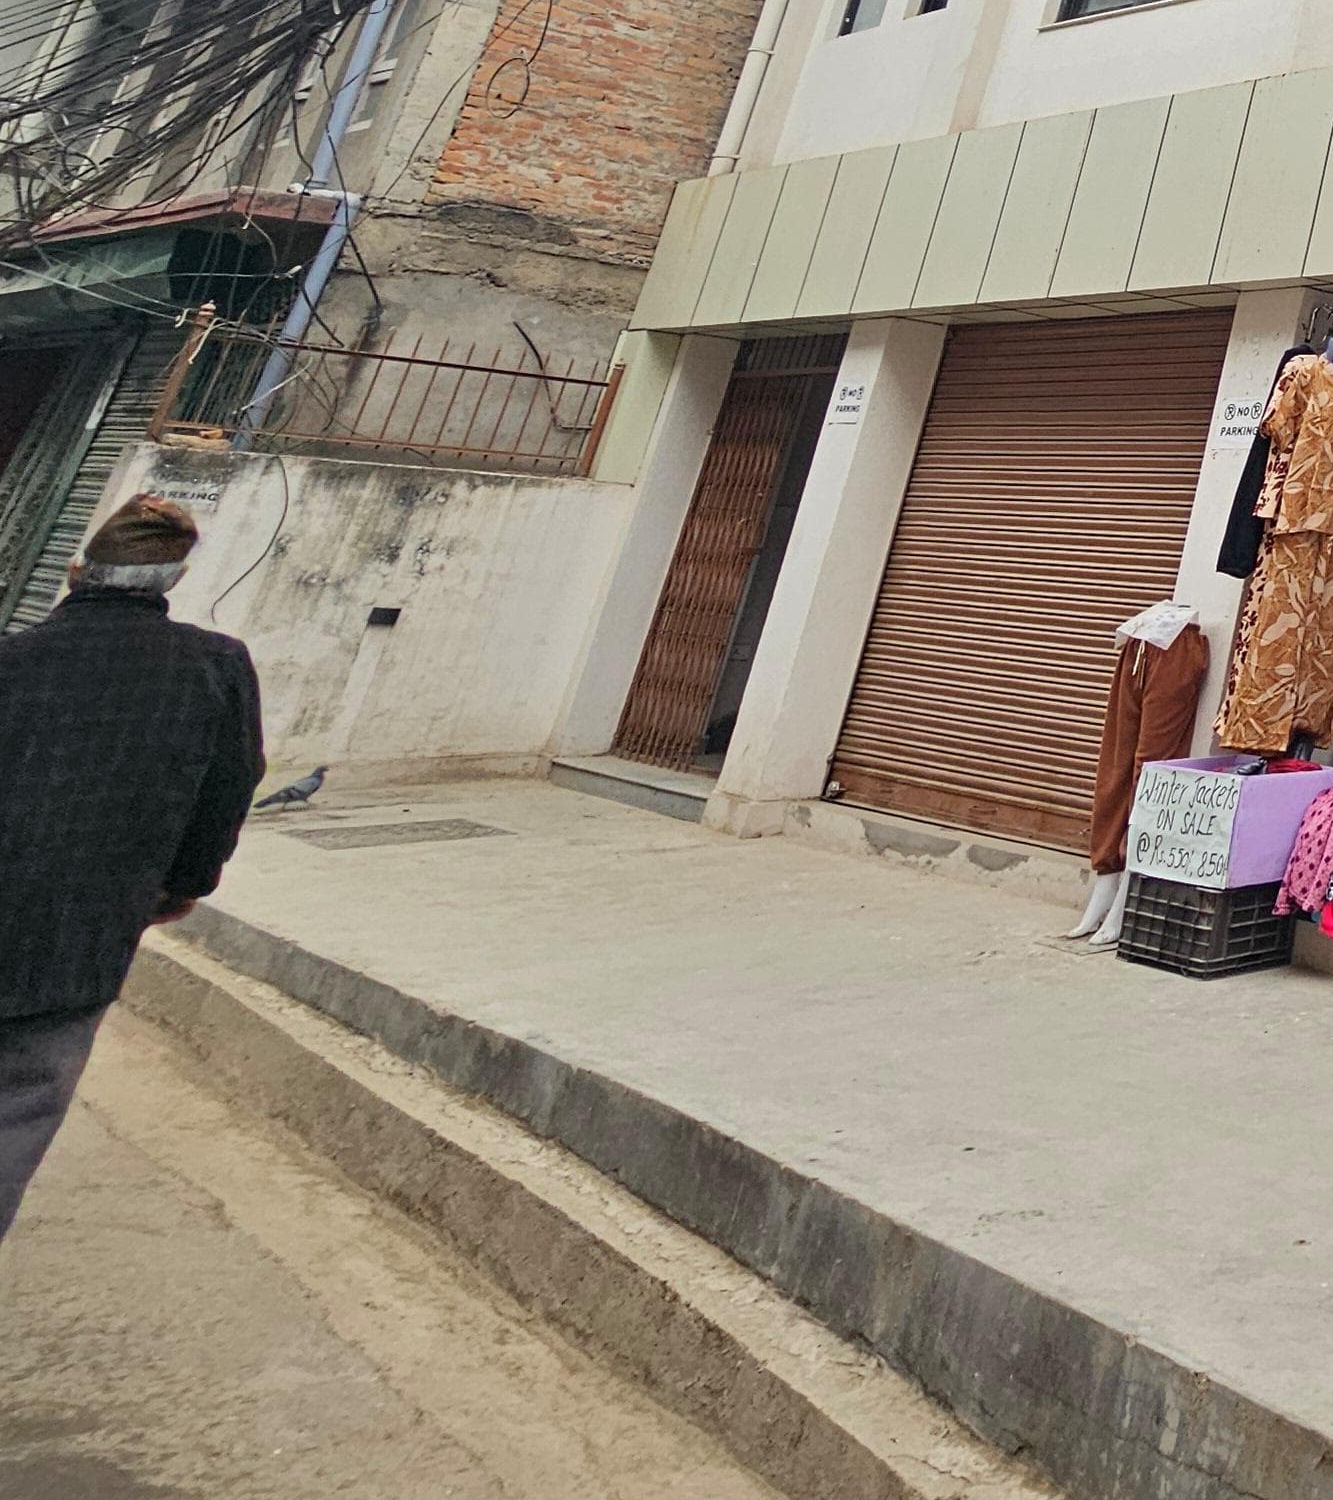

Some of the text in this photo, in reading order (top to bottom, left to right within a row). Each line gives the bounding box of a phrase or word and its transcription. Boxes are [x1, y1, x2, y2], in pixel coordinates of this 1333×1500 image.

[835, 404, 861, 413] PARKING
[1237, 406, 1250, 417] NO
[1219, 426, 1260, 437] PARKING
[1138, 770, 1239, 810] Winter Jackets
[1156, 808, 1217, 837] ON SALE
